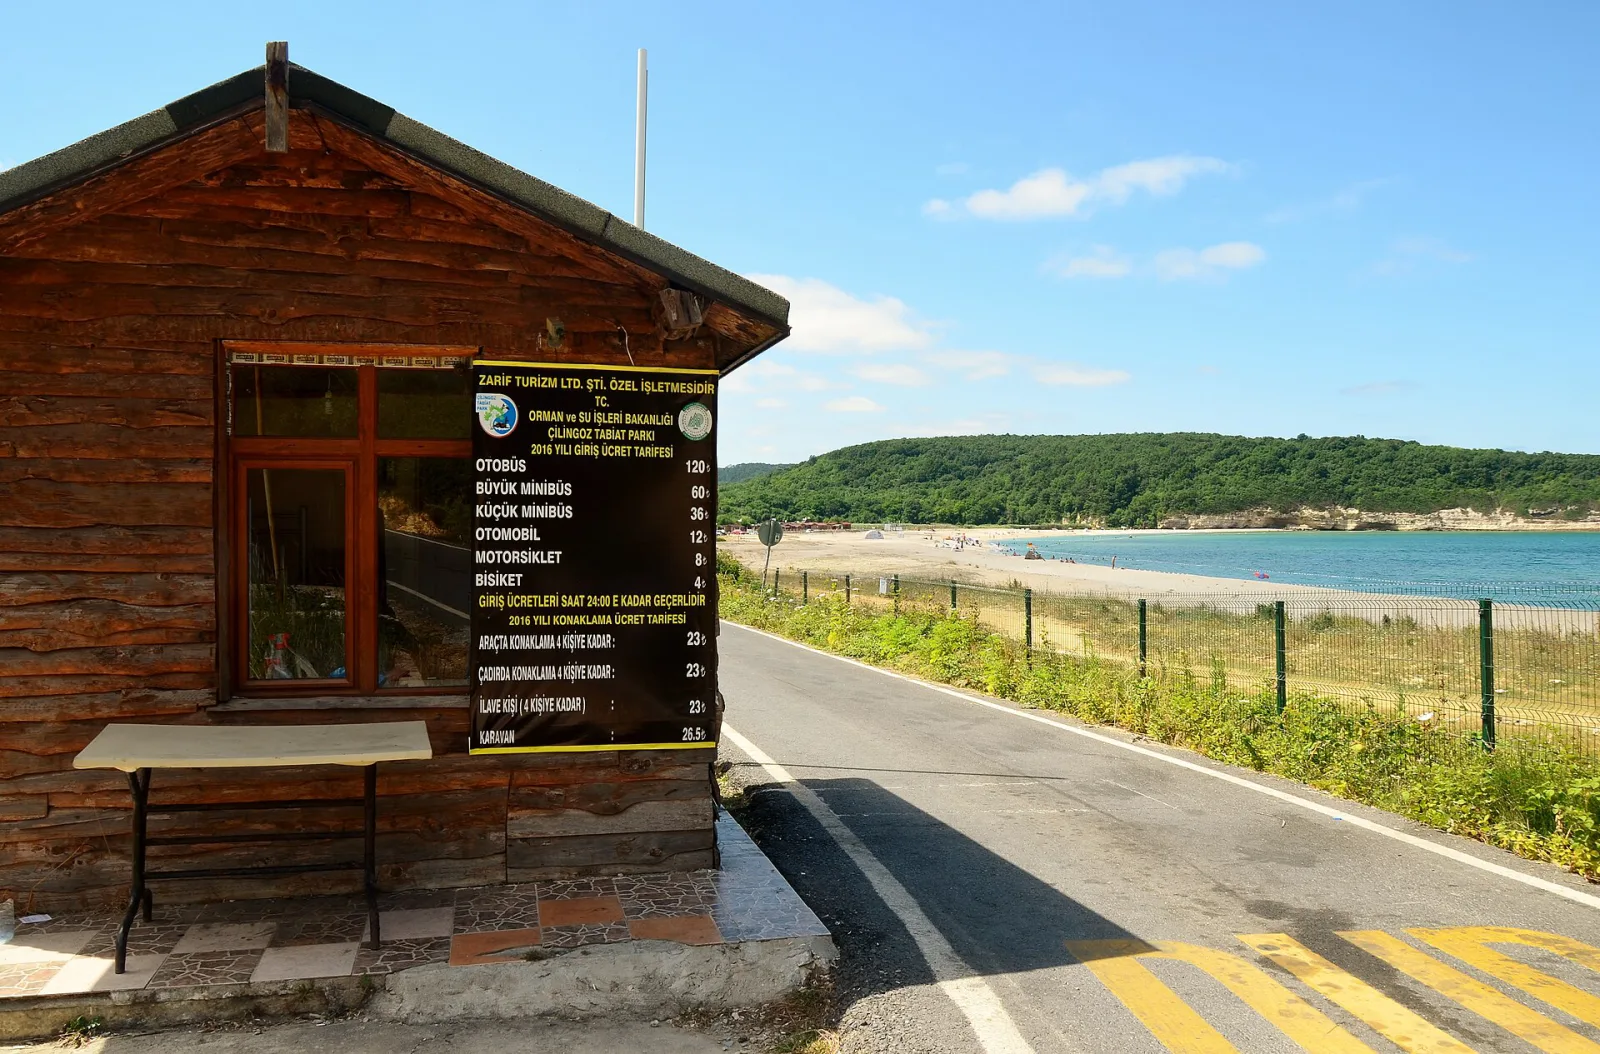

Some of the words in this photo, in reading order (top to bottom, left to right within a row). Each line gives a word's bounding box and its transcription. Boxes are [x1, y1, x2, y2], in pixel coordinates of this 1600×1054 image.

[479, 373, 512, 386] ZARİF
[515, 375, 557, 388] TURİZM
[561, 378, 583, 388] LTD.
[587, 377, 606, 392] ŞTİ.
[610, 377, 638, 391] ÖZEL
[641, 379, 714, 394] İŞLETMESİDİR
[595, 396, 609, 407] TC.
[529, 410, 563, 422] ORMAN
[566, 414, 576, 422] ve
[579, 412, 591, 422] SU
[594, 410, 622, 426] İŞLERİ
[625, 413, 673, 425] BAKANLIĞI
[548, 426, 591, 440] ÇİLİNGOZ
[594, 426, 626, 439] TABİAT
[629, 430, 654, 441] PARKI
[532, 444, 552, 455] 2016
[555, 444, 571, 455] YILI
[575, 442, 599, 458] GİRİŞ
[602, 443, 632, 456] ÜCRET
[634, 444, 673, 458] TARİFESİ
[476, 456, 526, 472] OTOBÜS
[476, 479, 517, 495] BÜYÜK
[521, 479, 572, 495] MİNİBÜS
[476, 502, 518, 521] KÜÇÜK
[522, 502, 572, 518] MİNİBÜS
[476, 525, 540, 541] OTOMOBİL
[476, 548, 562, 563] MOTORSİKLET
[476, 570, 523, 586] BİSİKET
[479, 592, 504, 610] GİRİŞ
[508, 592, 558, 607] ÜCRETLERİ
[562, 595, 585, 607] SAAT
[587, 595, 610, 607] 24:00
[613, 595, 618, 606] E
[621, 595, 651, 606] KADAR
[654, 592, 705, 609] GEÇERLİDİR
[509, 616, 530, 625] 2016
[533, 616, 550, 625] YILI
[553, 615, 612, 625] KONAKLAMA
[615, 612, 645, 624] ÜCRET
[647, 612, 686, 624] TARİFESİ
[479, 635, 508, 654] ARAÇTA
[510, 635, 555, 649] KONAKLAMA
[557, 635, 561, 649] 4
[563, 631, 585, 653] KİŞİYE
[479, 666, 510, 685] ÇADIRDA
[512, 666, 556, 680] KONAKLAMA
[558, 666, 562, 679] 4
[564, 662, 585, 683] KİŞİYE
[480, 695, 501, 713] İLAVE
[503, 695, 517, 717] KİŞİ
[531, 694, 554, 716] KİŞİYE
[480, 730, 514, 744] KARAVAN
